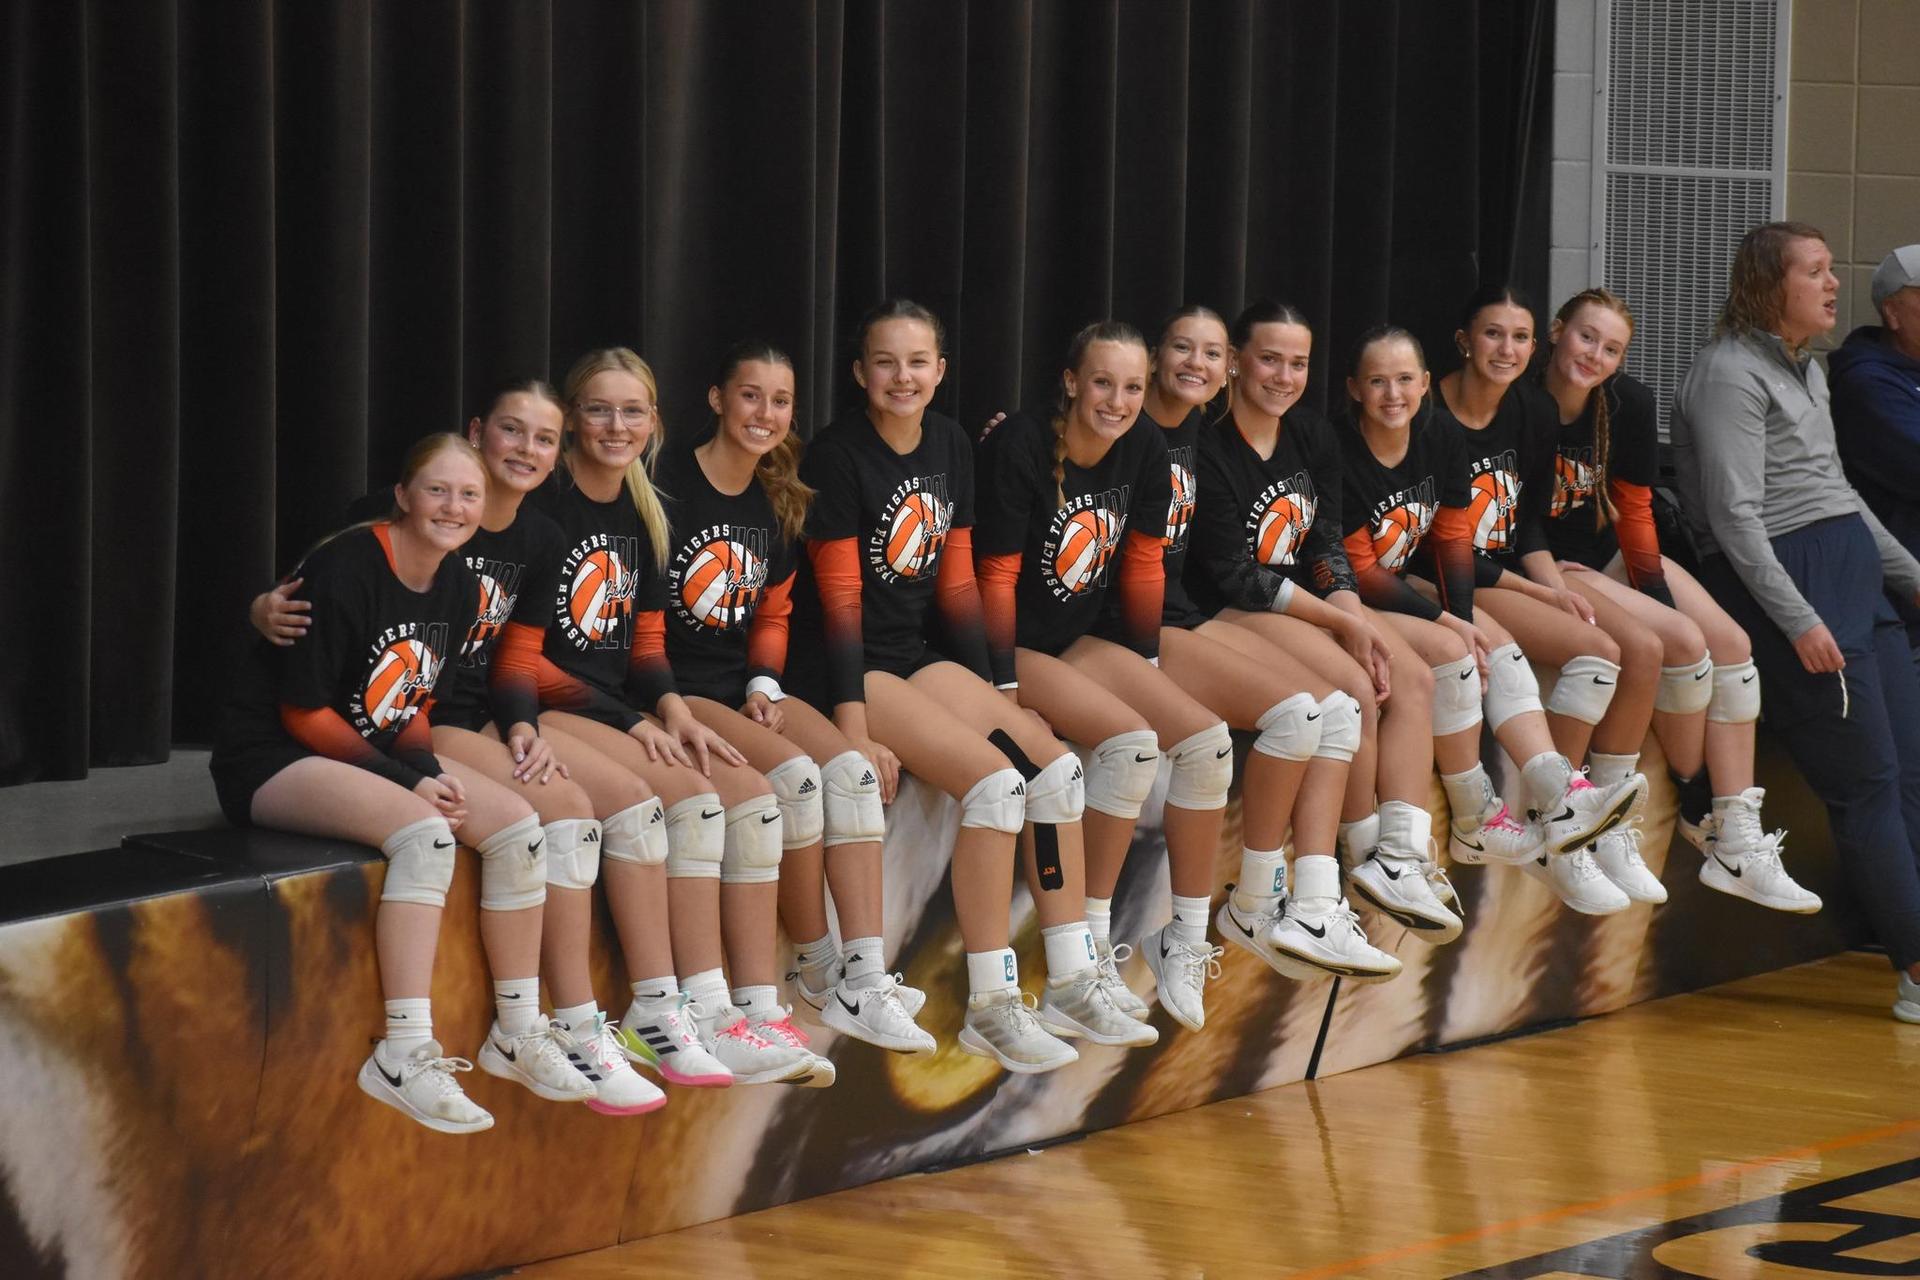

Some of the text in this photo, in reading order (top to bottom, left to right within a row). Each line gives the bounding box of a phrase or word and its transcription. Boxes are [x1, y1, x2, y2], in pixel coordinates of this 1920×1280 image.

[676, 524, 730, 564] TIGERS
[869, 476, 920, 584] IPSWICH TIGERS
[1040, 493, 1093, 603] IPSWICH TIGERS
[1246, 480, 1286, 530] TIGERS
[556, 533, 608, 652] IPSWICH TIGERS
